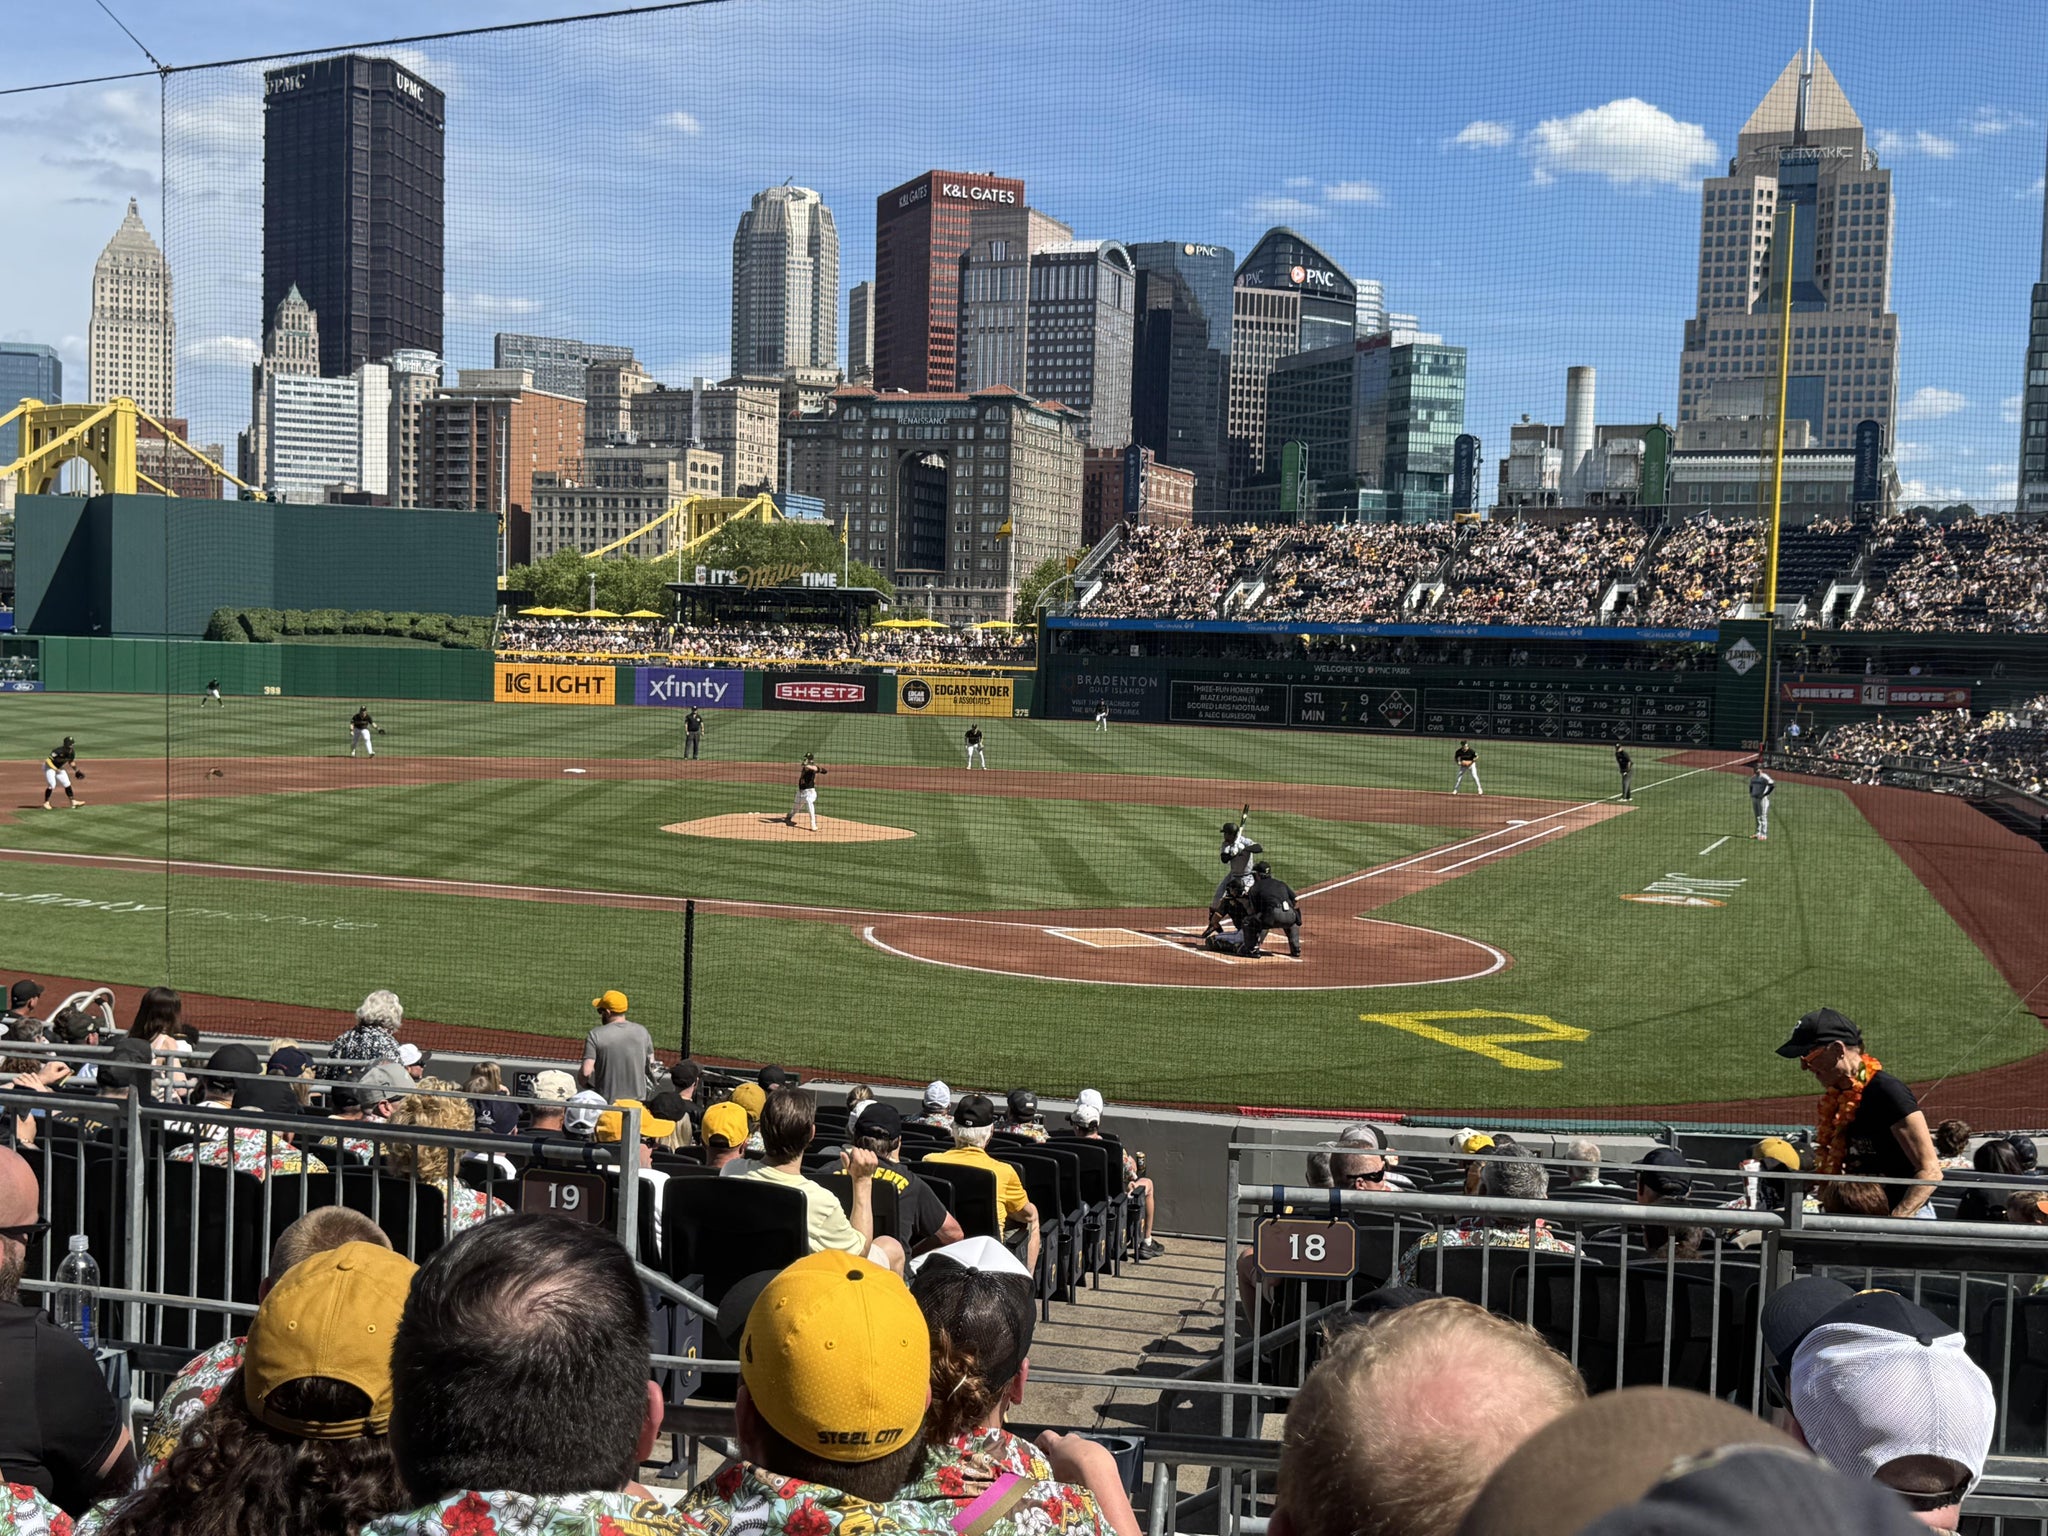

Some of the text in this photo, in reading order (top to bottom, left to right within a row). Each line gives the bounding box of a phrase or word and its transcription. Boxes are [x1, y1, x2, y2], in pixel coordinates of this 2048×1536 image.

[265, 73, 306, 96] UPMC
[396, 72, 424, 102] UPMC
[909, 184, 928, 203] GATES
[942, 183, 1015, 204] K&L GATES
[1195, 245, 1217, 257] PNC
[1245, 269, 1264, 286] PNC
[1305, 268, 1334, 287] PNC
[897, 417, 947, 425] RENAISSANCE
[710, 562, 837, 594] IT'S Miller TIME
[1313, 665, 1352, 673] WELCOME
[1391, 667, 1411, 675] PARK
[1737, 660, 1746, 669] 21
[537, 675, 605, 694] LIGHT
[1077, 674, 1158, 688] BRADENTON
[1287, 674, 1360, 683] UPDATE
[649, 674, 729, 702] xfinity
[781, 686, 859, 699] SHEETZ
[934, 684, 1010, 698] EDGAR SNYDER
[1089, 686, 1145, 695] GULF ISLANDS
[1193, 684, 1229, 693] THREE-RUN
[1230, 686, 1254, 694] HOMER
[1457, 679, 1675, 693] AMERICAN LEAGUE
[958, 696, 991, 705] ASSOCIATES
[1304, 692, 1369, 705] STL 9
[1791, 688, 1855, 699] SHEETZ
[1890, 692, 1945, 702] SHOTZ
[1014, 708, 1029, 717] 375
[1187, 702, 1214, 710] SCORED
[1231, 704, 1270, 712] NOOTBAAR
[1341, 702, 1348, 712] 7
[1388, 702, 1402, 710] OUT
[1221, 712, 1256, 720] BURLESON
[1301, 710, 1368, 723] MIN 4
[548, 1182, 580, 1210] 19
[1289, 1233, 1326, 1261] 18
[817, 1428, 903, 1445] STEEL CITY
